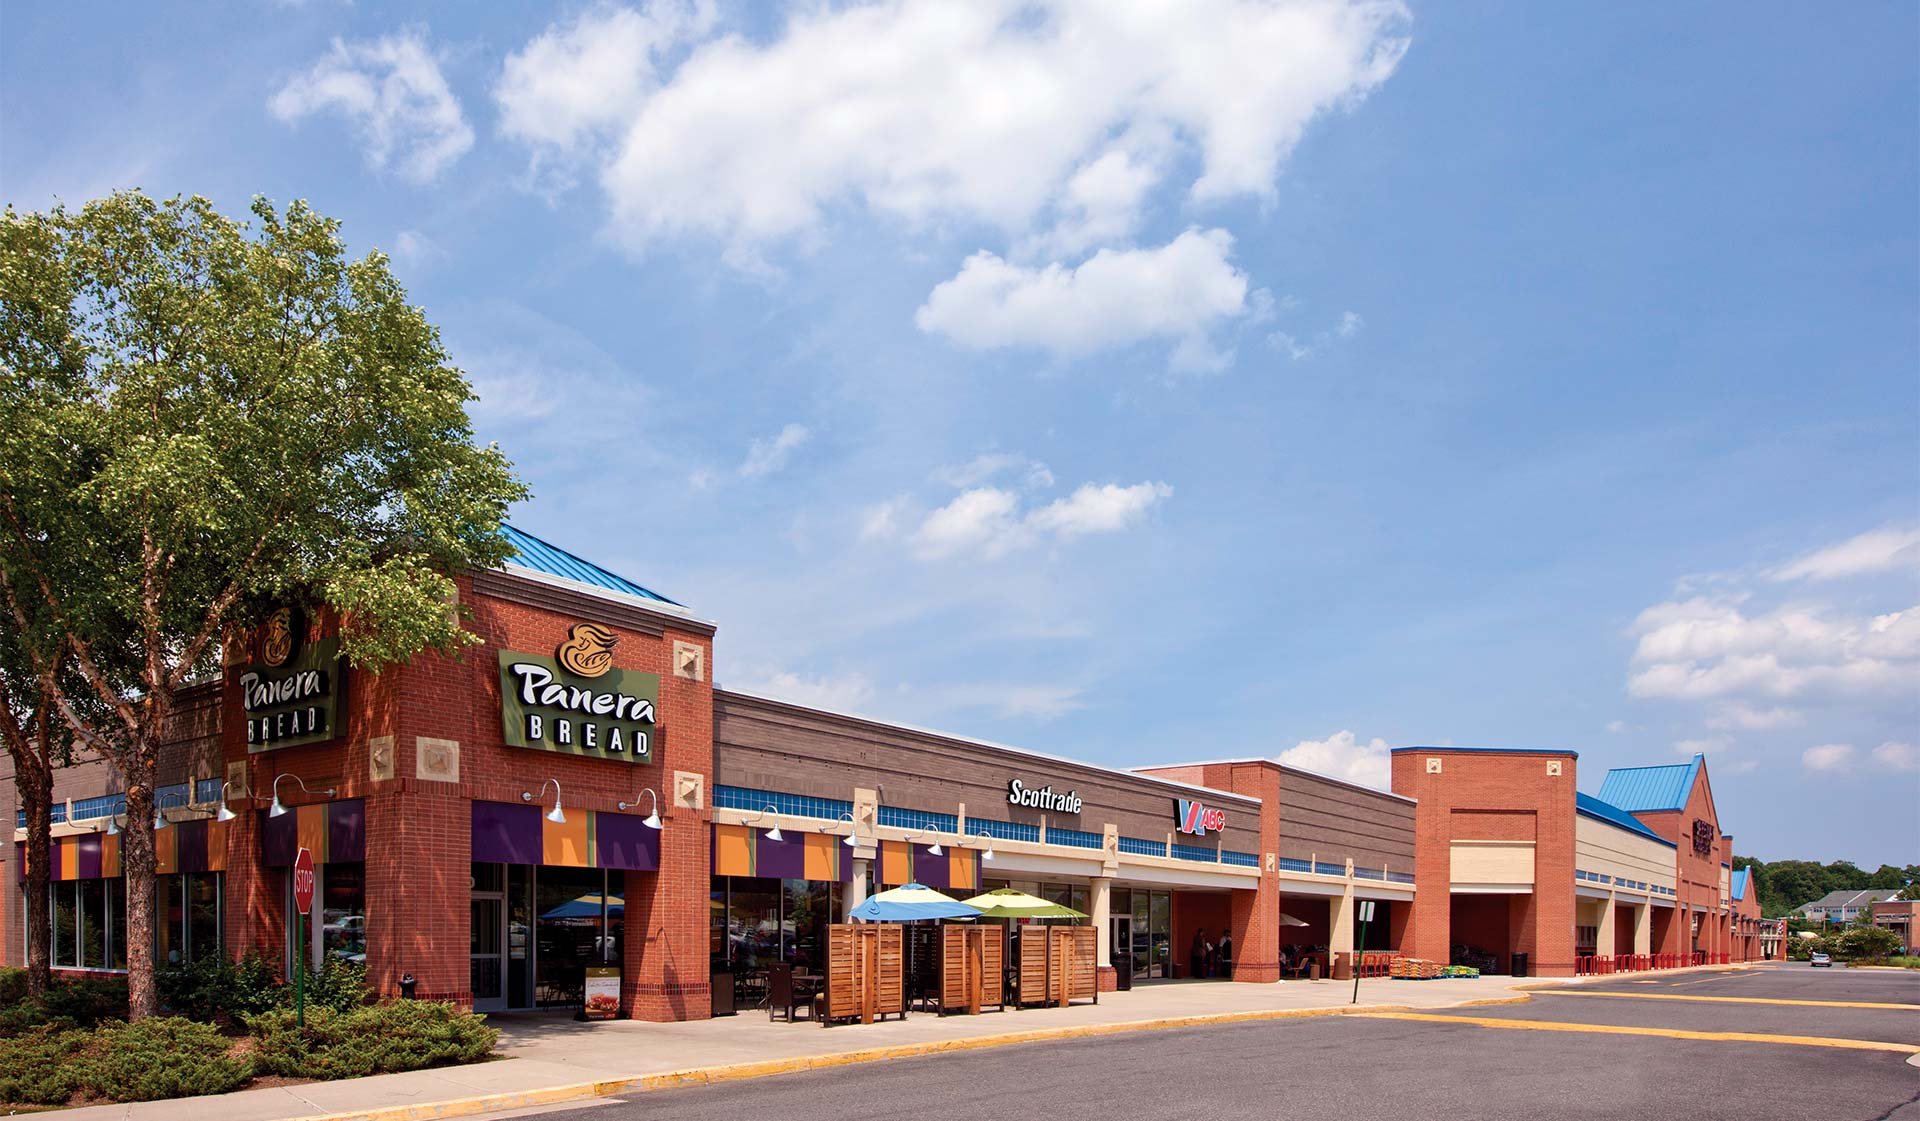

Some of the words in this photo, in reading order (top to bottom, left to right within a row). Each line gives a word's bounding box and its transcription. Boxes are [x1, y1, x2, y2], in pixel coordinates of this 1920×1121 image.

[240, 670, 320, 710] Panera
[514, 663, 656, 723] Panera
[247, 707, 316, 742] BREAD
[530, 714, 648, 755] BREAD
[1009, 779, 1082, 814] Scottrade
[296, 869, 314, 893] STOP
